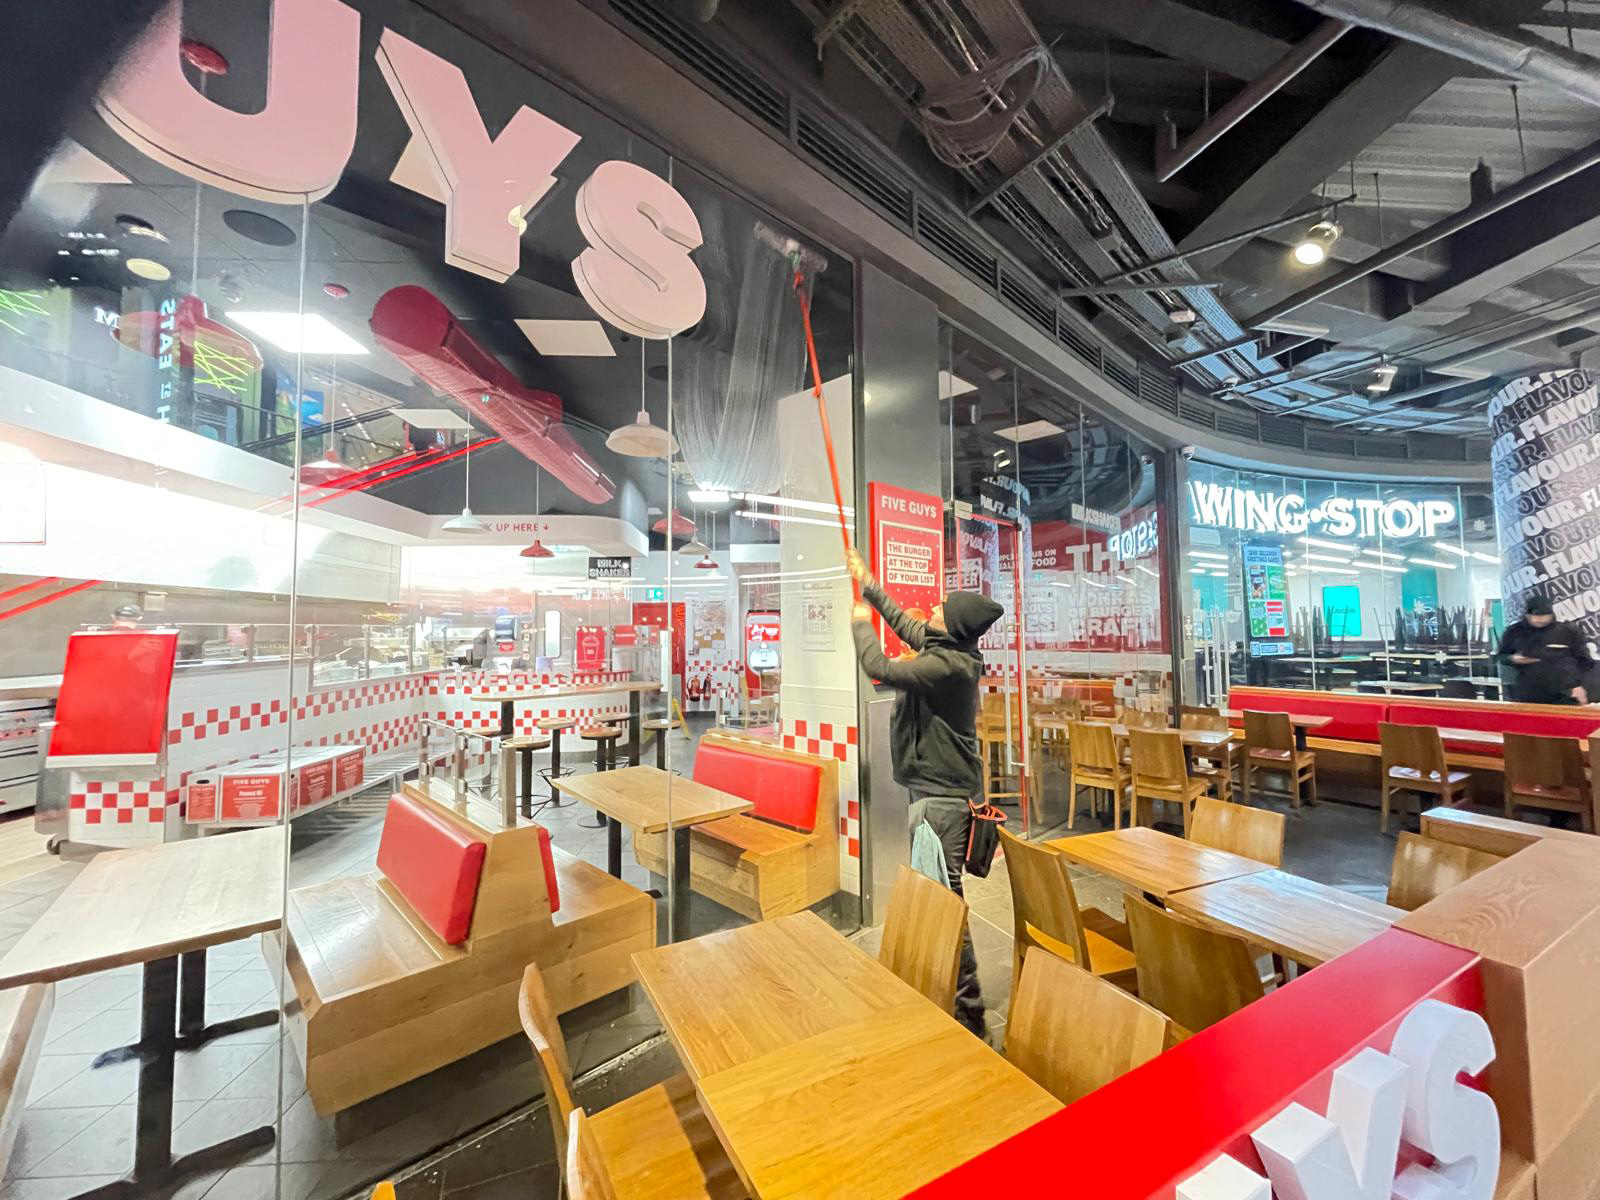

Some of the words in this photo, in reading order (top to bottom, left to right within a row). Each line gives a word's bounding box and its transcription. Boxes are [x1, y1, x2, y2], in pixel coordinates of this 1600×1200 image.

[881, 495, 906, 512] FIVE
[908, 501, 937, 519] GUYS
[1323, 495, 1456, 538] STOP
[496, 523, 510, 532] UP
[513, 523, 539, 532] HERE
[888, 543, 902, 553] THE
[904, 545, 931, 557] BURGER
[1044, 549, 1057, 557] ON
[597, 559, 622, 569] MILK
[888, 558, 898, 567] AT
[899, 559, 913, 569] THE
[914, 561, 928, 570] TOP
[888, 572, 898, 581] OF
[899, 573, 919, 583] YOUR
[920, 575, 934, 585] LIST
